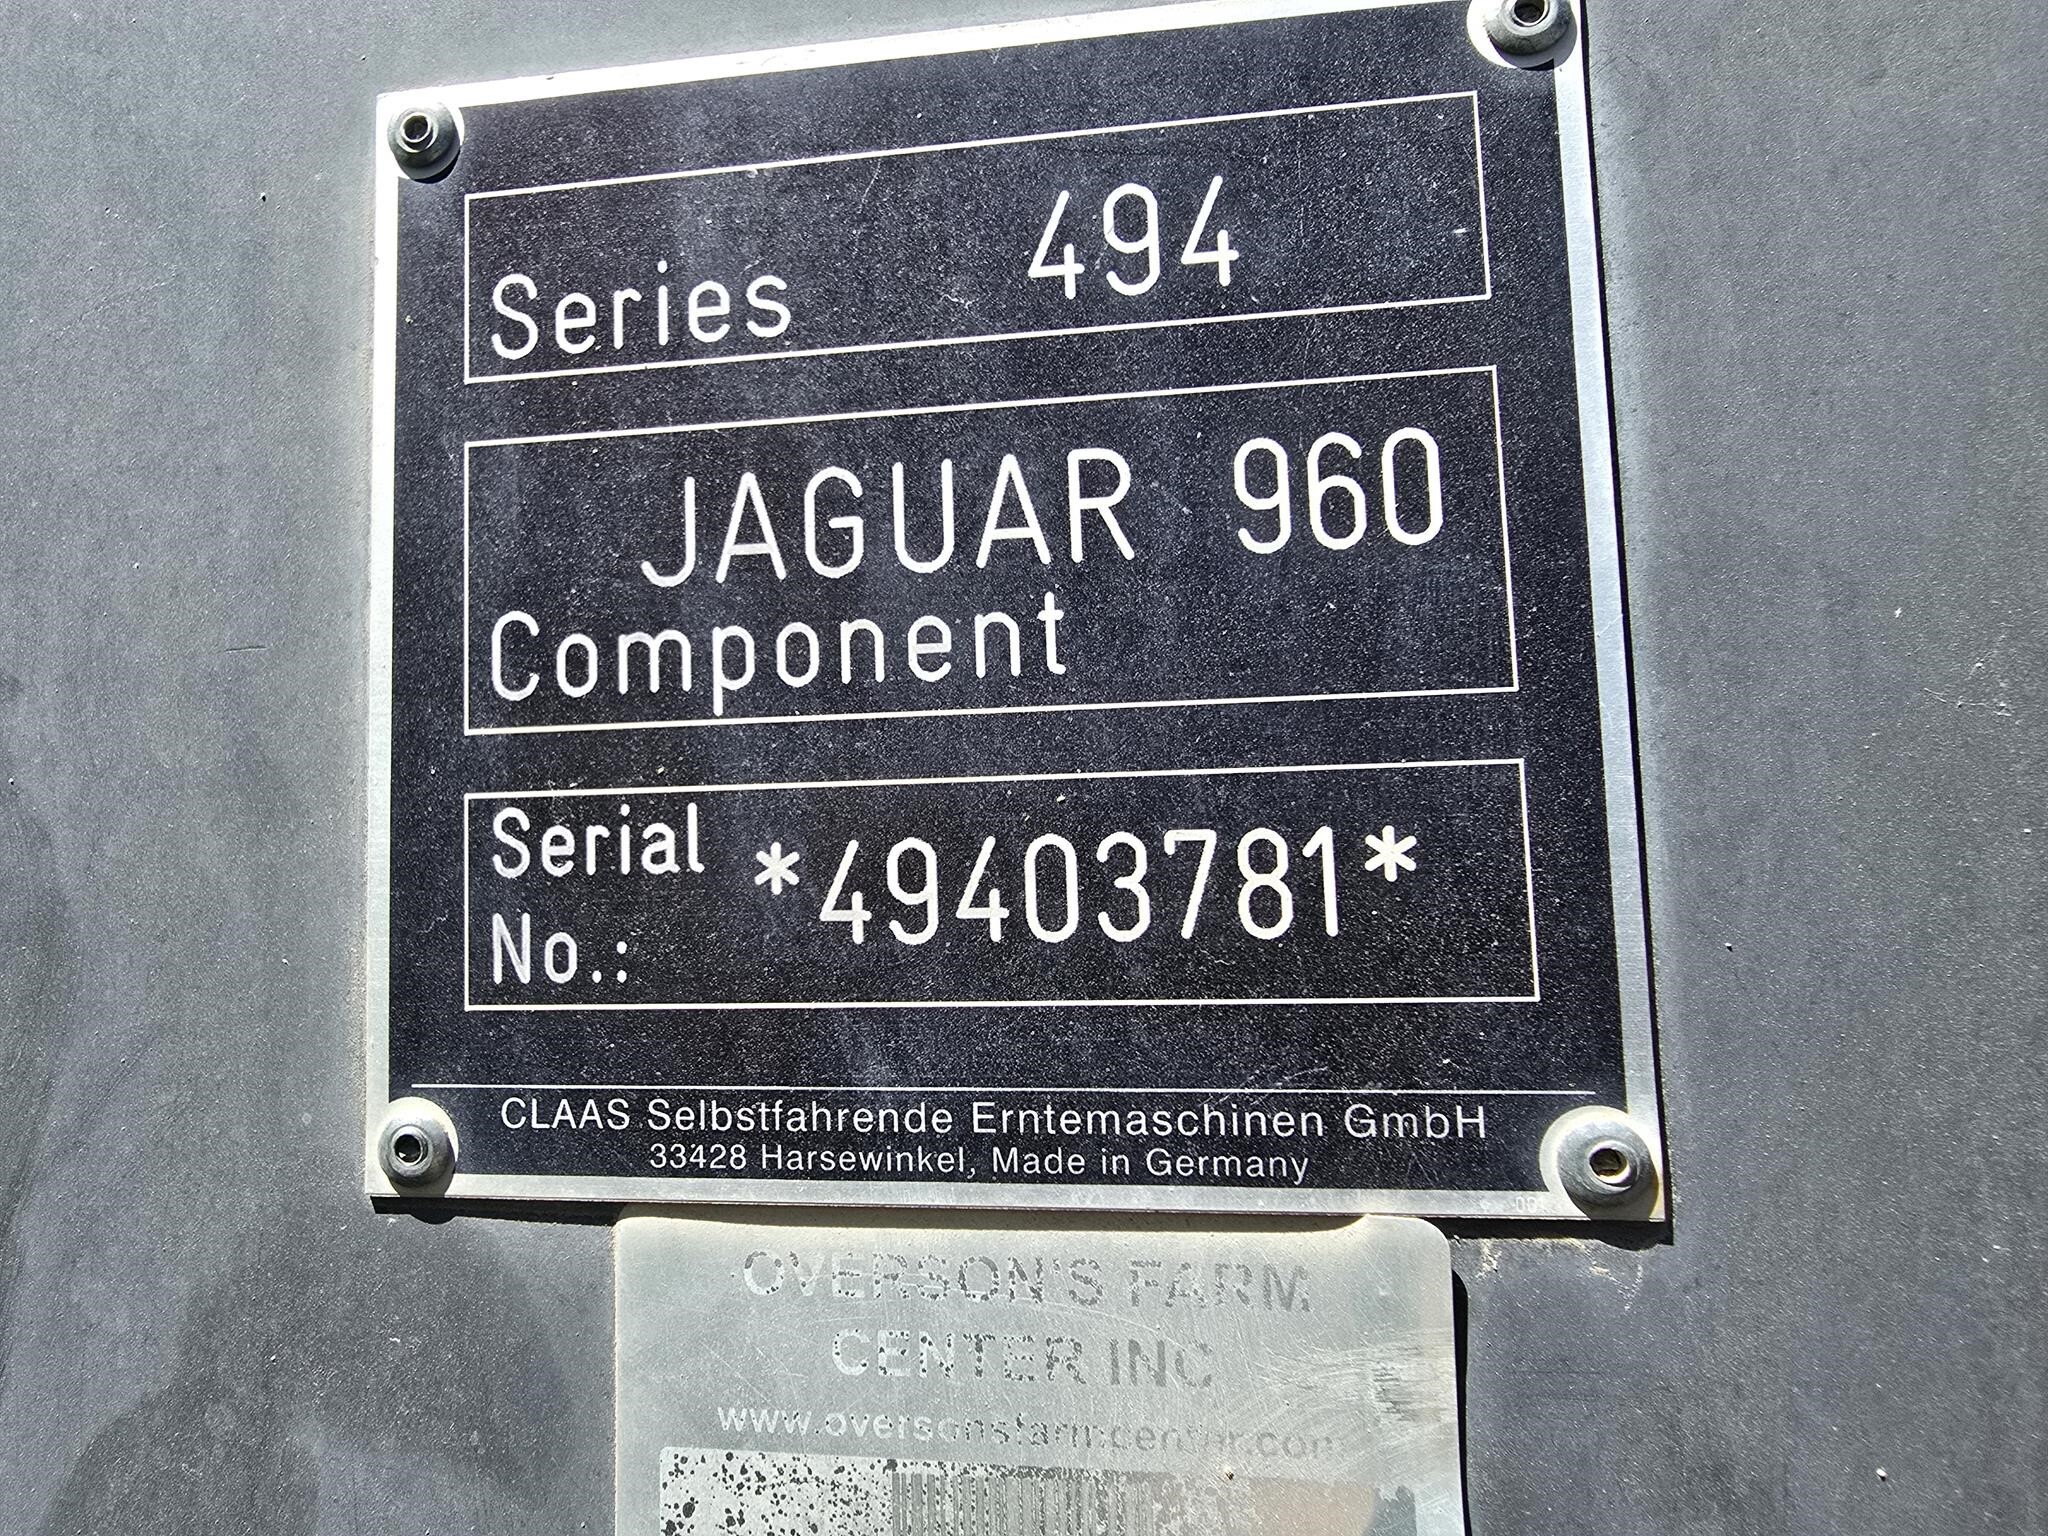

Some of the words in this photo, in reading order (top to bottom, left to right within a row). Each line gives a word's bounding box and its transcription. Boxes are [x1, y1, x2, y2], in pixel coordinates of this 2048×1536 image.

[491, 259, 793, 361] Series
[1027, 175, 1240, 300] 494
[640, 447, 1135, 588] JAGUAR
[1233, 427, 1444, 555] 960
[491, 591, 1067, 717] Component
[491, 802, 705, 879] Serial
[492, 912, 628, 985] No.:
[501, 1097, 630, 1131] CLAAS
[647, 1098, 953, 1134] Selbstfahrende
[972, 1101, 1323, 1138] Erntemaschinen
[1344, 1103, 1487, 1139] GmbH
[650, 1143, 747, 1170] 33428
[761, 1143, 977, 1180] Harsewinkel,
[993, 1146, 1085, 1175] Made
[1102, 1147, 1130, 1175] in
[1146, 1148, 1309, 1186] Germany
[743, 1250, 1103, 1306] OVERSON'S
[1130, 1259, 1311, 1312] FARM
[831, 1328, 1087, 1385] CENTER
[1109, 1337, 1213, 1388] INC
